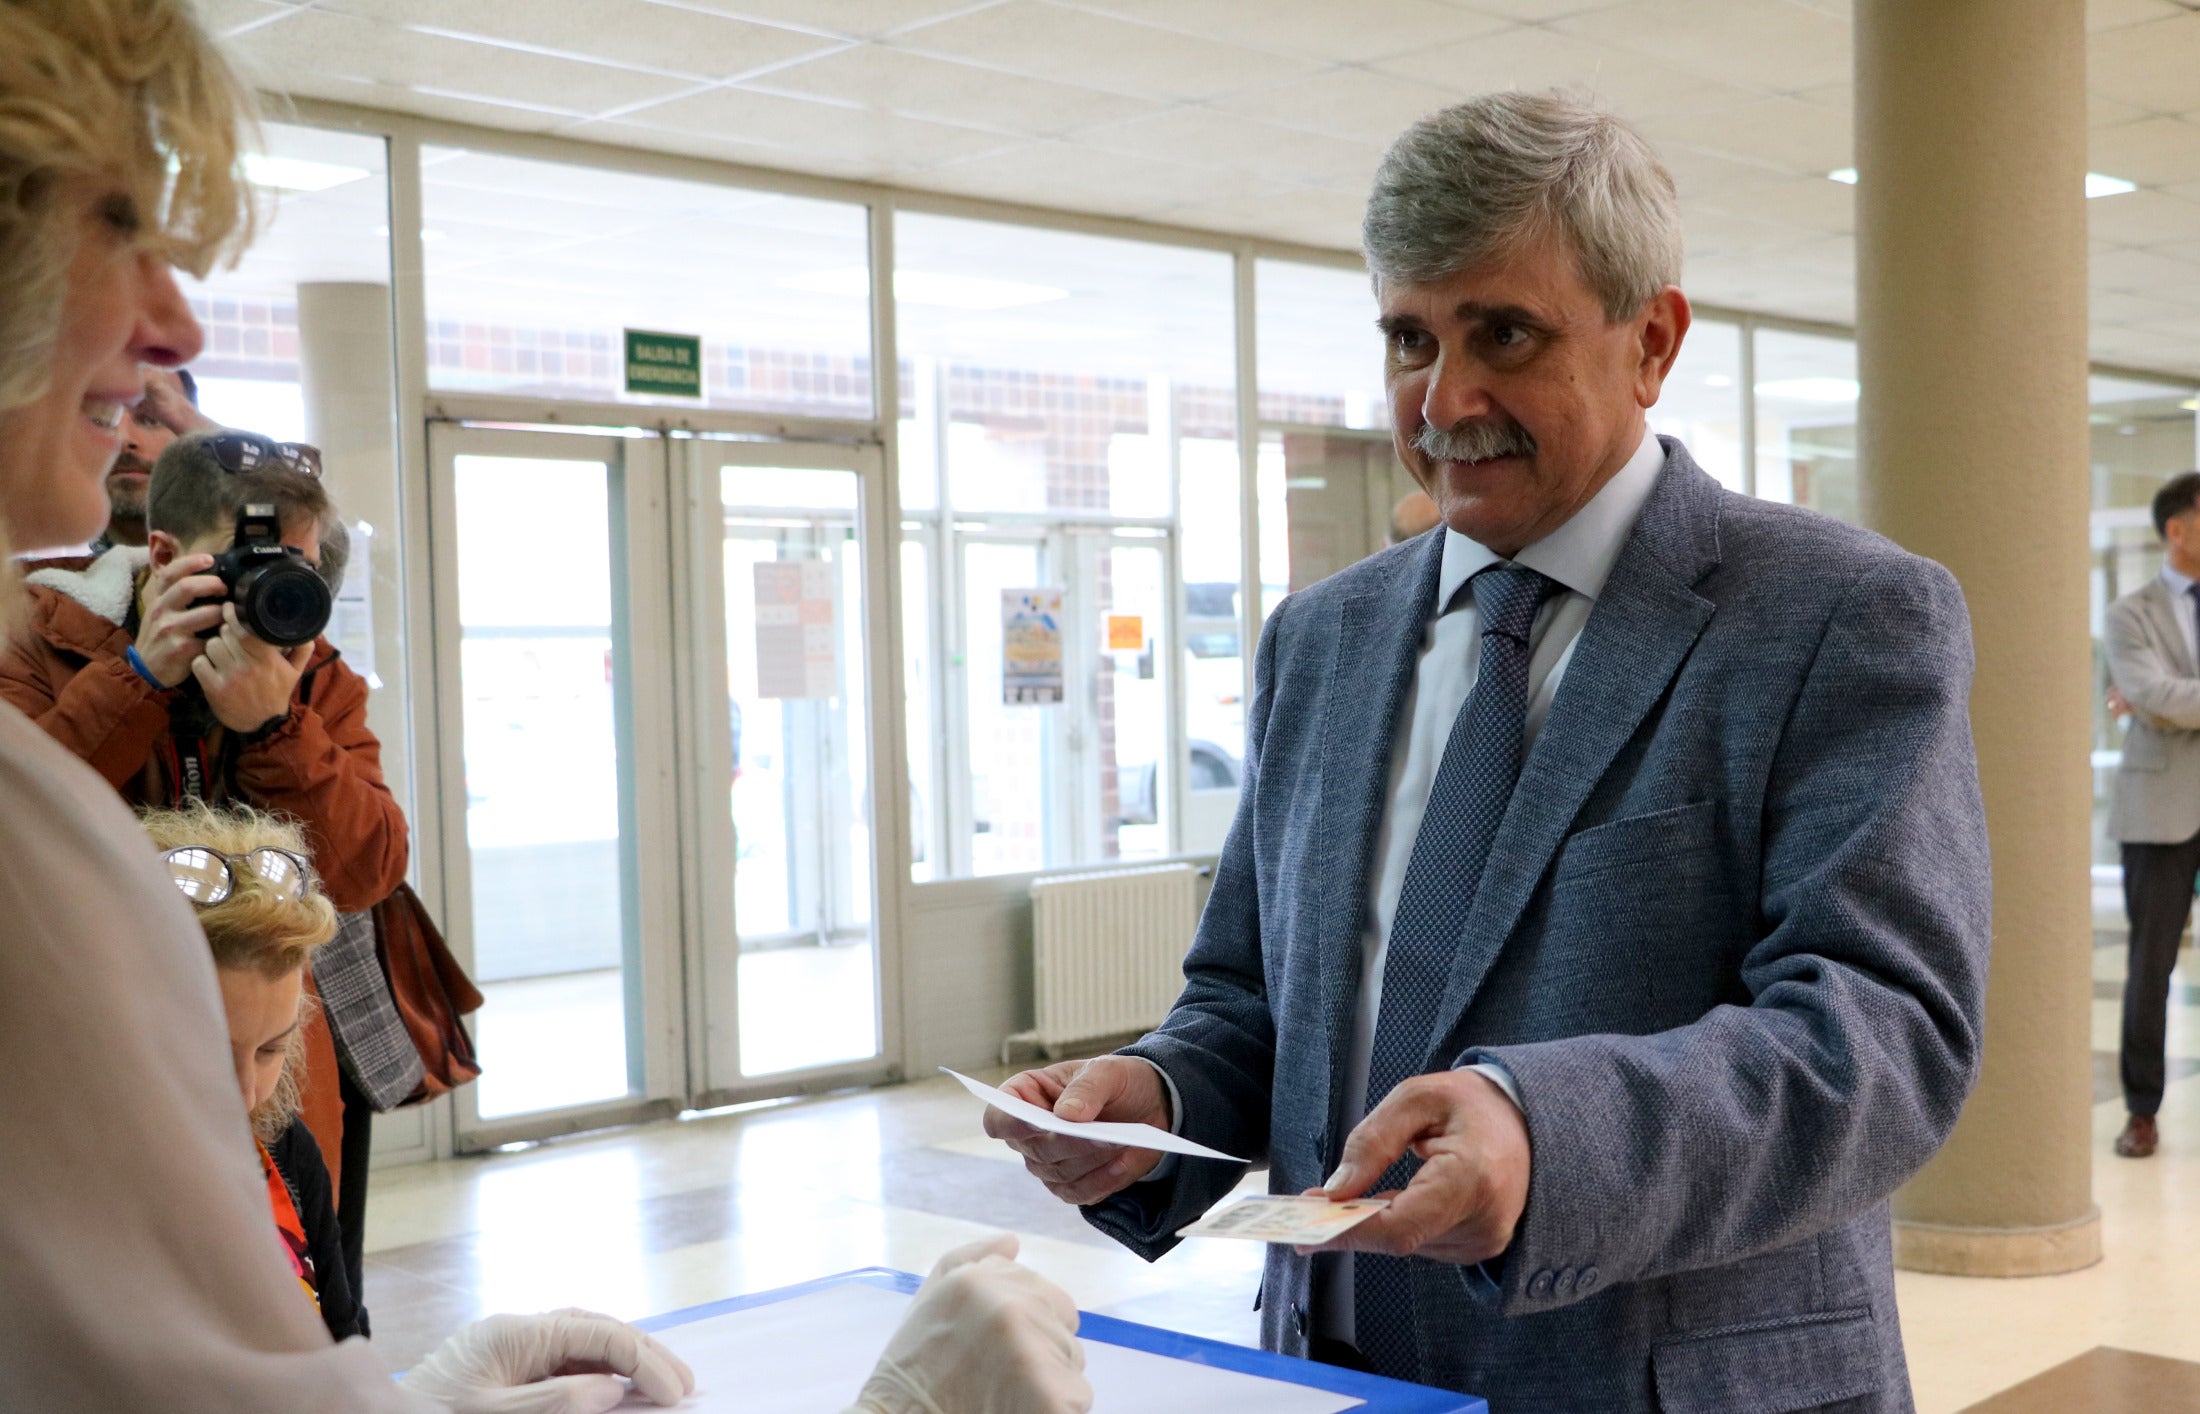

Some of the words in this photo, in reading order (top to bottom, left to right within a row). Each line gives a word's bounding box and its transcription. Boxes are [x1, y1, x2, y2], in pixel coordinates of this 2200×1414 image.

[635, 344, 674, 361] SALIDA
[675, 348, 690, 364] DE
[628, 364, 697, 384] EMERGENCIA
[252, 545, 283, 554] Canon
[184, 756, 201, 797] non
